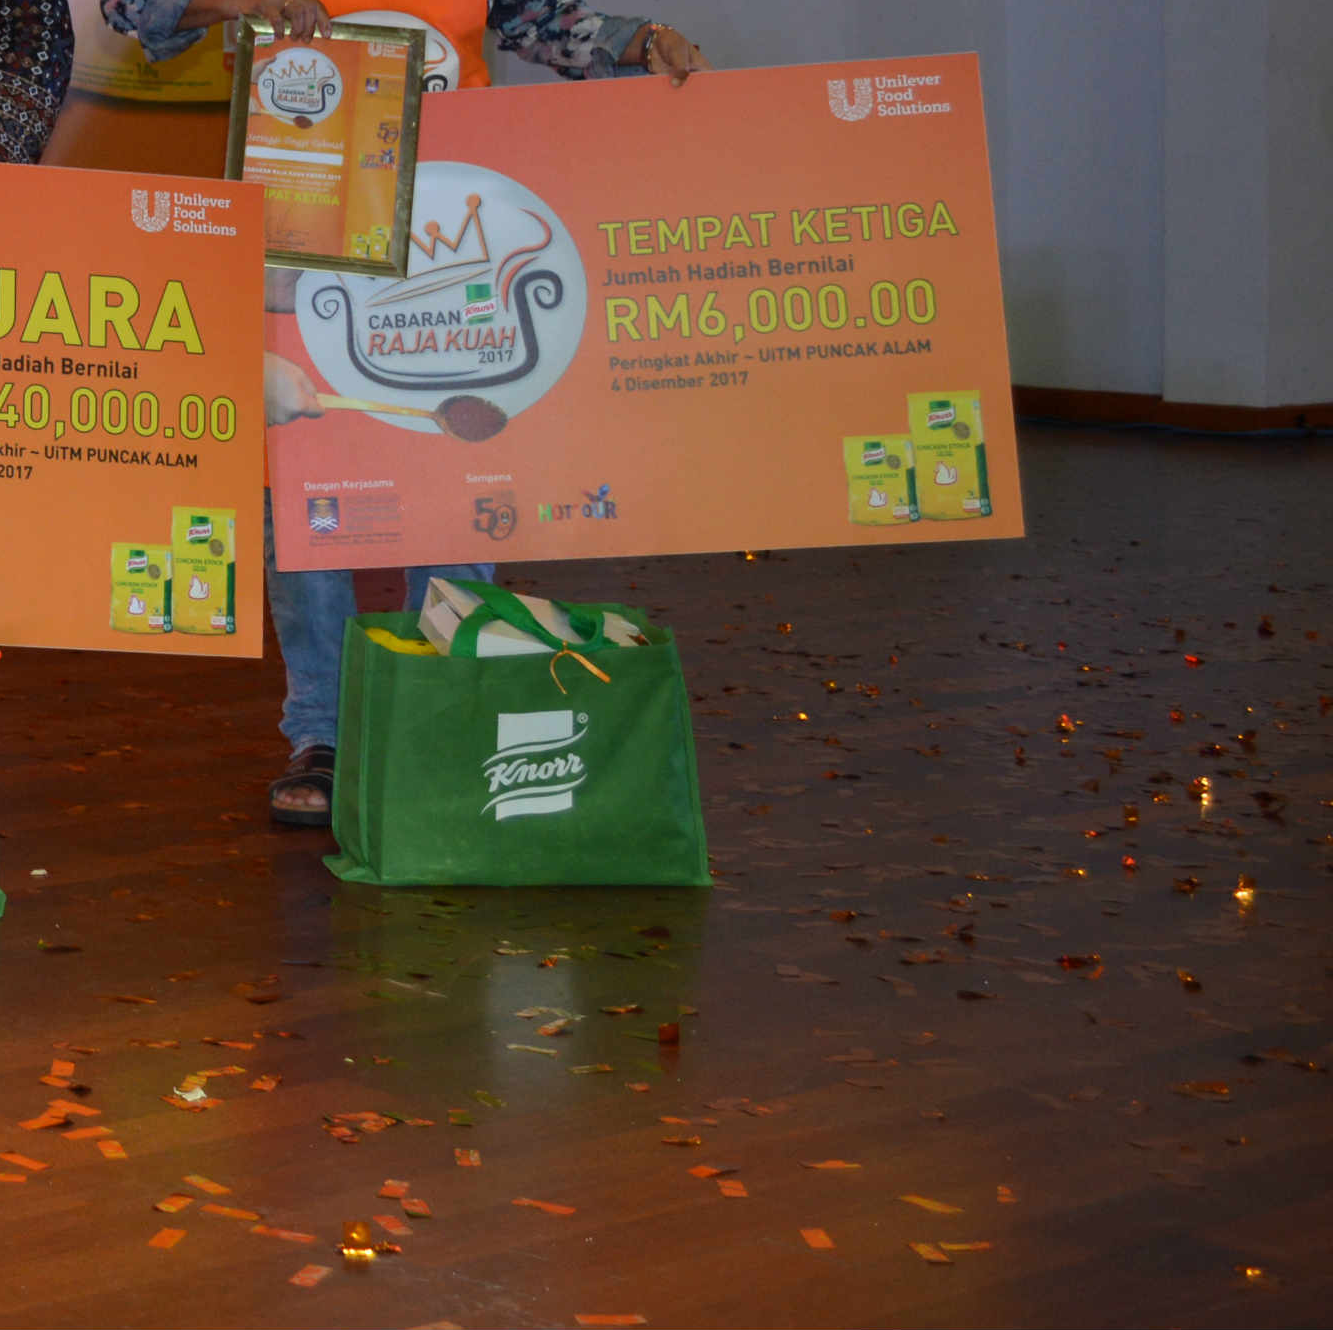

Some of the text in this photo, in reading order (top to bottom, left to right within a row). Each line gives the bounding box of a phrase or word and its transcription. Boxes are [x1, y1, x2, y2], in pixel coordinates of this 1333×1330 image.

[875, 74, 942, 90] Unilever
[876, 88, 914, 104] Food
[877, 101, 952, 118] Solutions
[173, 192, 231, 209] Unilever
[173, 206, 206, 221] Food
[172, 219, 237, 237] Solutions
[597, 201, 960, 258] TEMPAT KETIGA
[601, 255, 855, 287] Jumlah Hadiah Bernilai
[369, 302, 496, 331] CABARAN Knorr
[604, 277, 938, 345] RM6,000.00
[367, 326, 516, 357] RAJA KUAH
[477, 350, 514, 364] 2017
[608, 339, 933, 372] Peringkat Akhir UiTM PUNCAK ALAM
[61, 357, 139, 381] Bernilai
[610, 371, 749, 392] 4 Disember 2017
[44, 446, 82, 462] UiTM
[86, 447, 151, 466] PUNCAK
[154, 452, 198, 469] ALAM
[303, 478, 394, 493] Dengan Kerjasama
[465, 473, 512, 485] Sempena
[484, 753, 585, 793] Knorr
